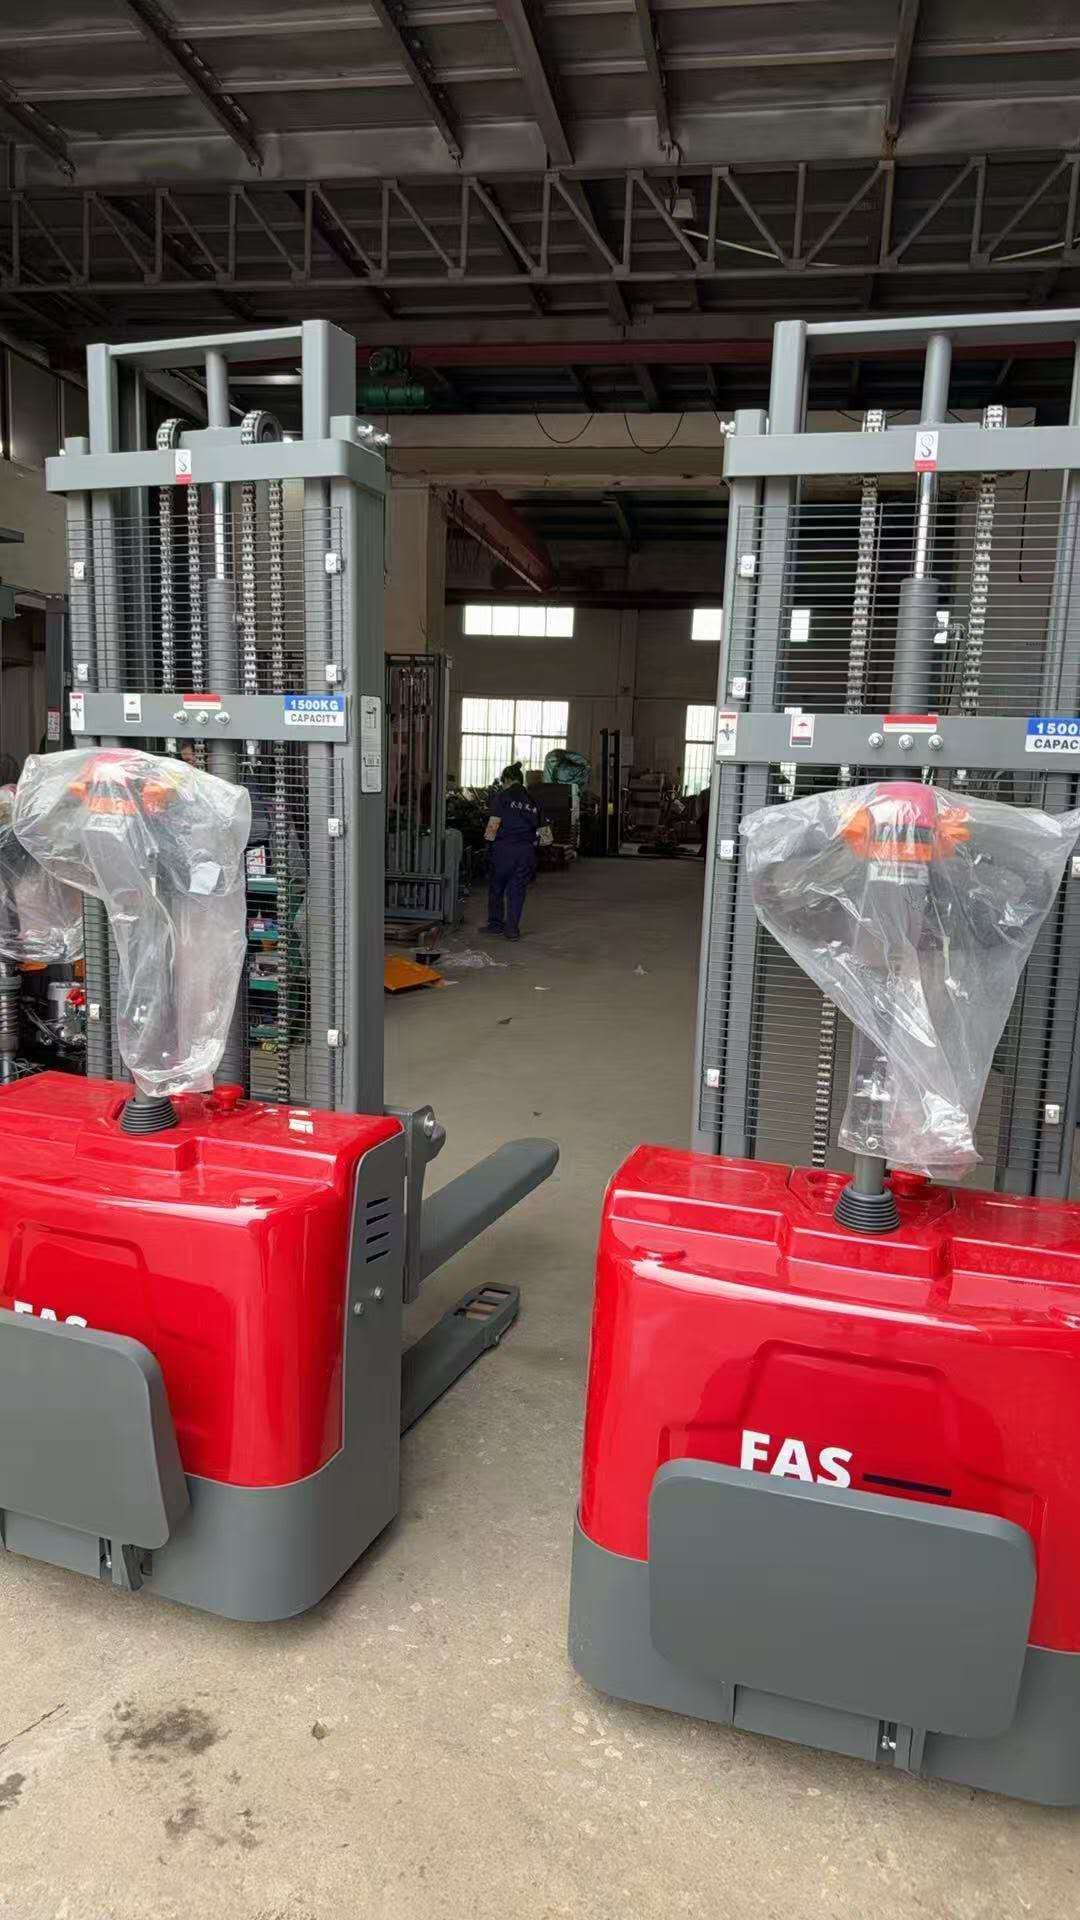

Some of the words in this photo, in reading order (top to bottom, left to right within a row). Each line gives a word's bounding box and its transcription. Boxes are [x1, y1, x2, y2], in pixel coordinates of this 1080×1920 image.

[290, 699, 339, 711] 1500KG
[290, 713, 337, 723] CAPACITY
[1036, 722, 1080, 735] 1500
[1034, 738, 1080, 750] CAPAC
[740, 1429, 853, 1488] FAS
